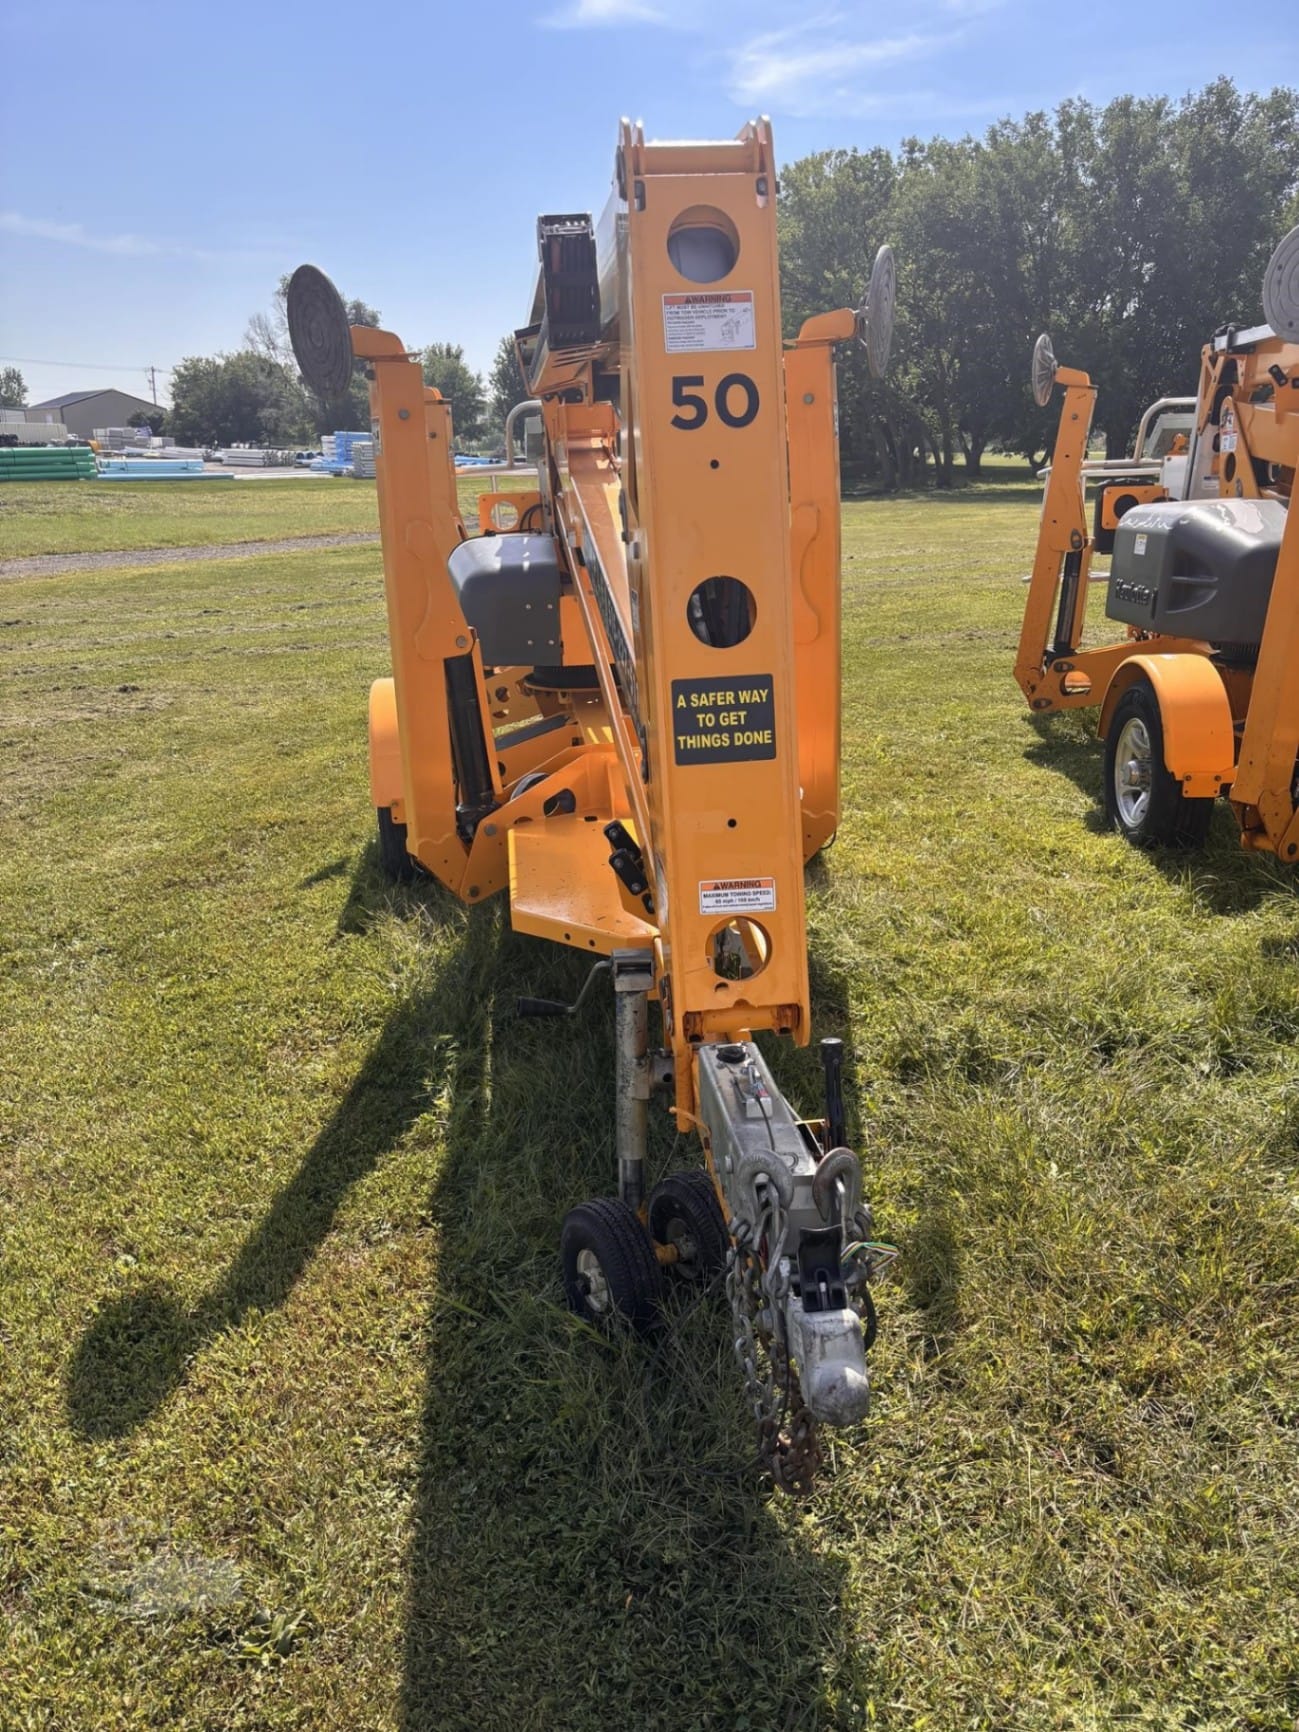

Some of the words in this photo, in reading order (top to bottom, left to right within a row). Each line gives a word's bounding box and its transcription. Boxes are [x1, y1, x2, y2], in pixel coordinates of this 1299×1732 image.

[690, 294, 731, 304] WARNING
[670, 373, 760, 430] 50
[677, 694, 687, 708] A
[690, 691, 735, 707] SAFER
[738, 689, 768, 704] WAY
[696, 713, 715, 727] TO
[719, 711, 747, 726] GET
[677, 733, 730, 750] THINGS
[734, 730, 772, 746] DONE
[720, 880, 761, 890] WARNING
